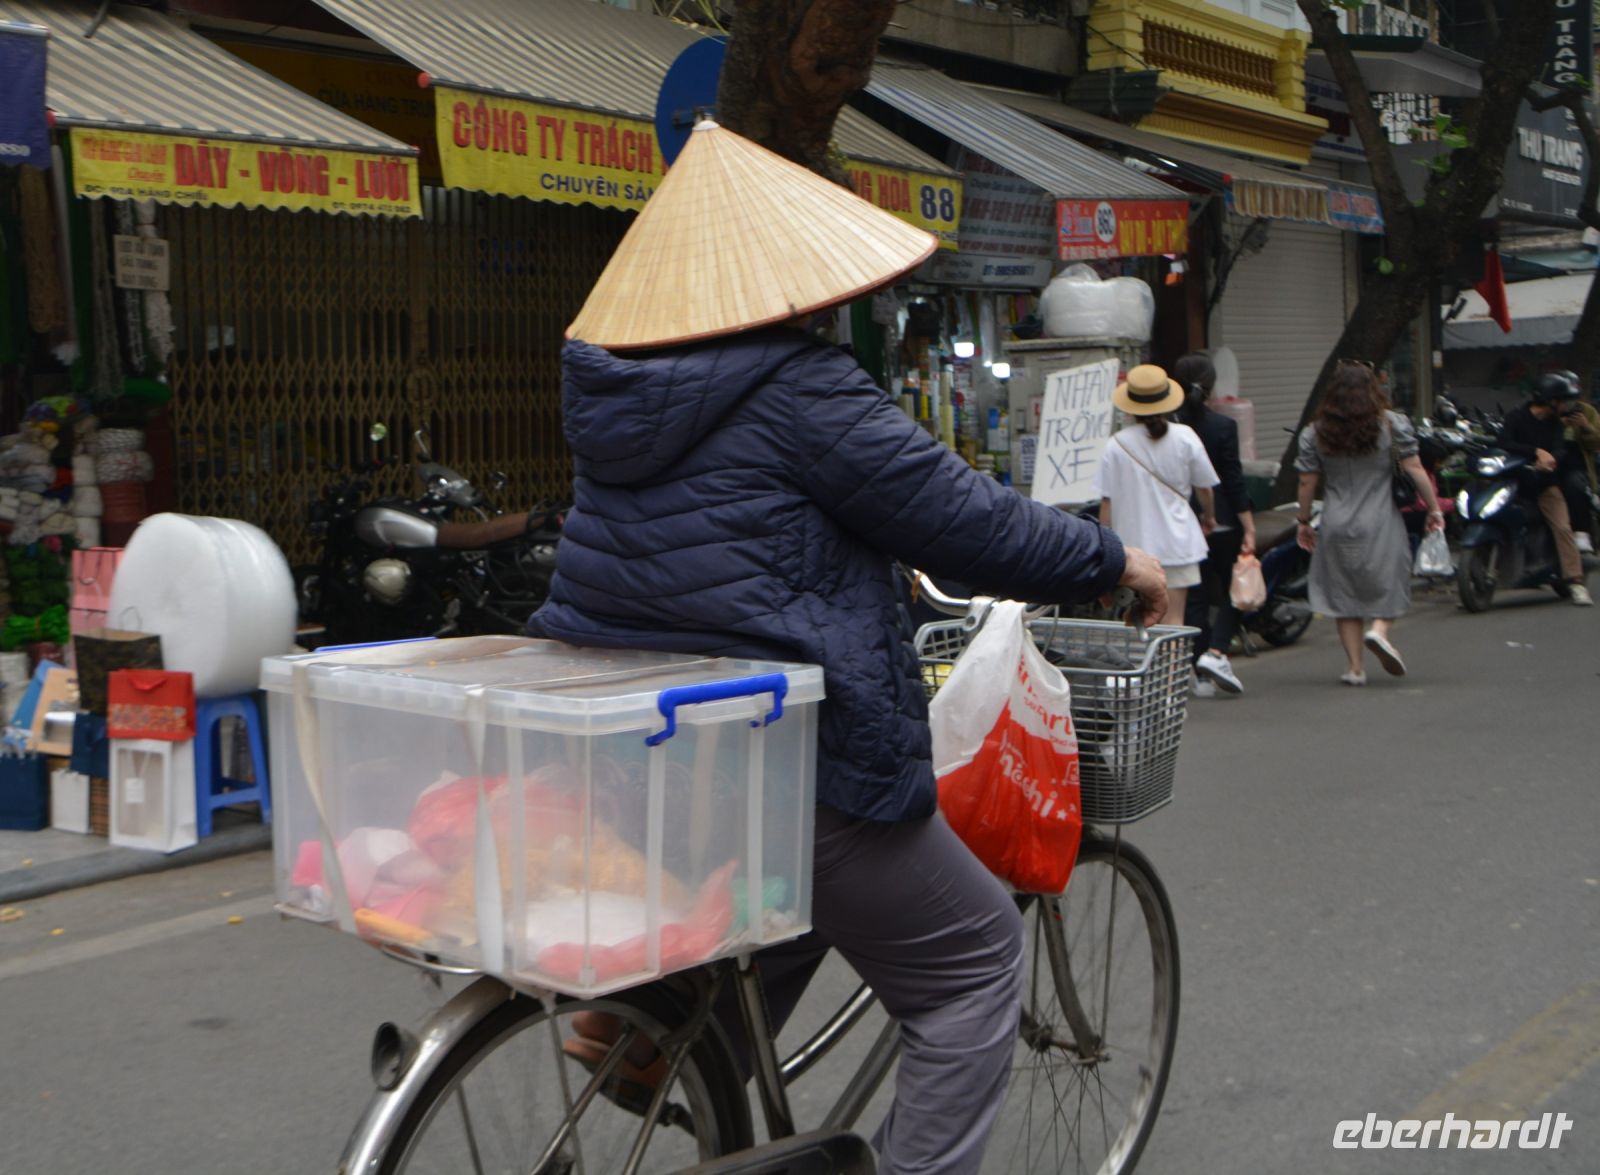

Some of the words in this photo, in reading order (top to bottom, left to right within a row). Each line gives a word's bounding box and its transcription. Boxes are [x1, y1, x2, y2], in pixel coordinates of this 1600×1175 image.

[1554, 19, 1578, 83] TRANG
[453, 98, 529, 157] CÔNG
[536, 115, 567, 161] TY
[574, 120, 655, 174] TRÁCH
[1517, 127, 1542, 162] THU
[1543, 134, 1583, 171] TRANG
[540, 173, 619, 199] CHUYÊN
[920, 184, 956, 223] 88
[1047, 446, 1097, 490] XE
